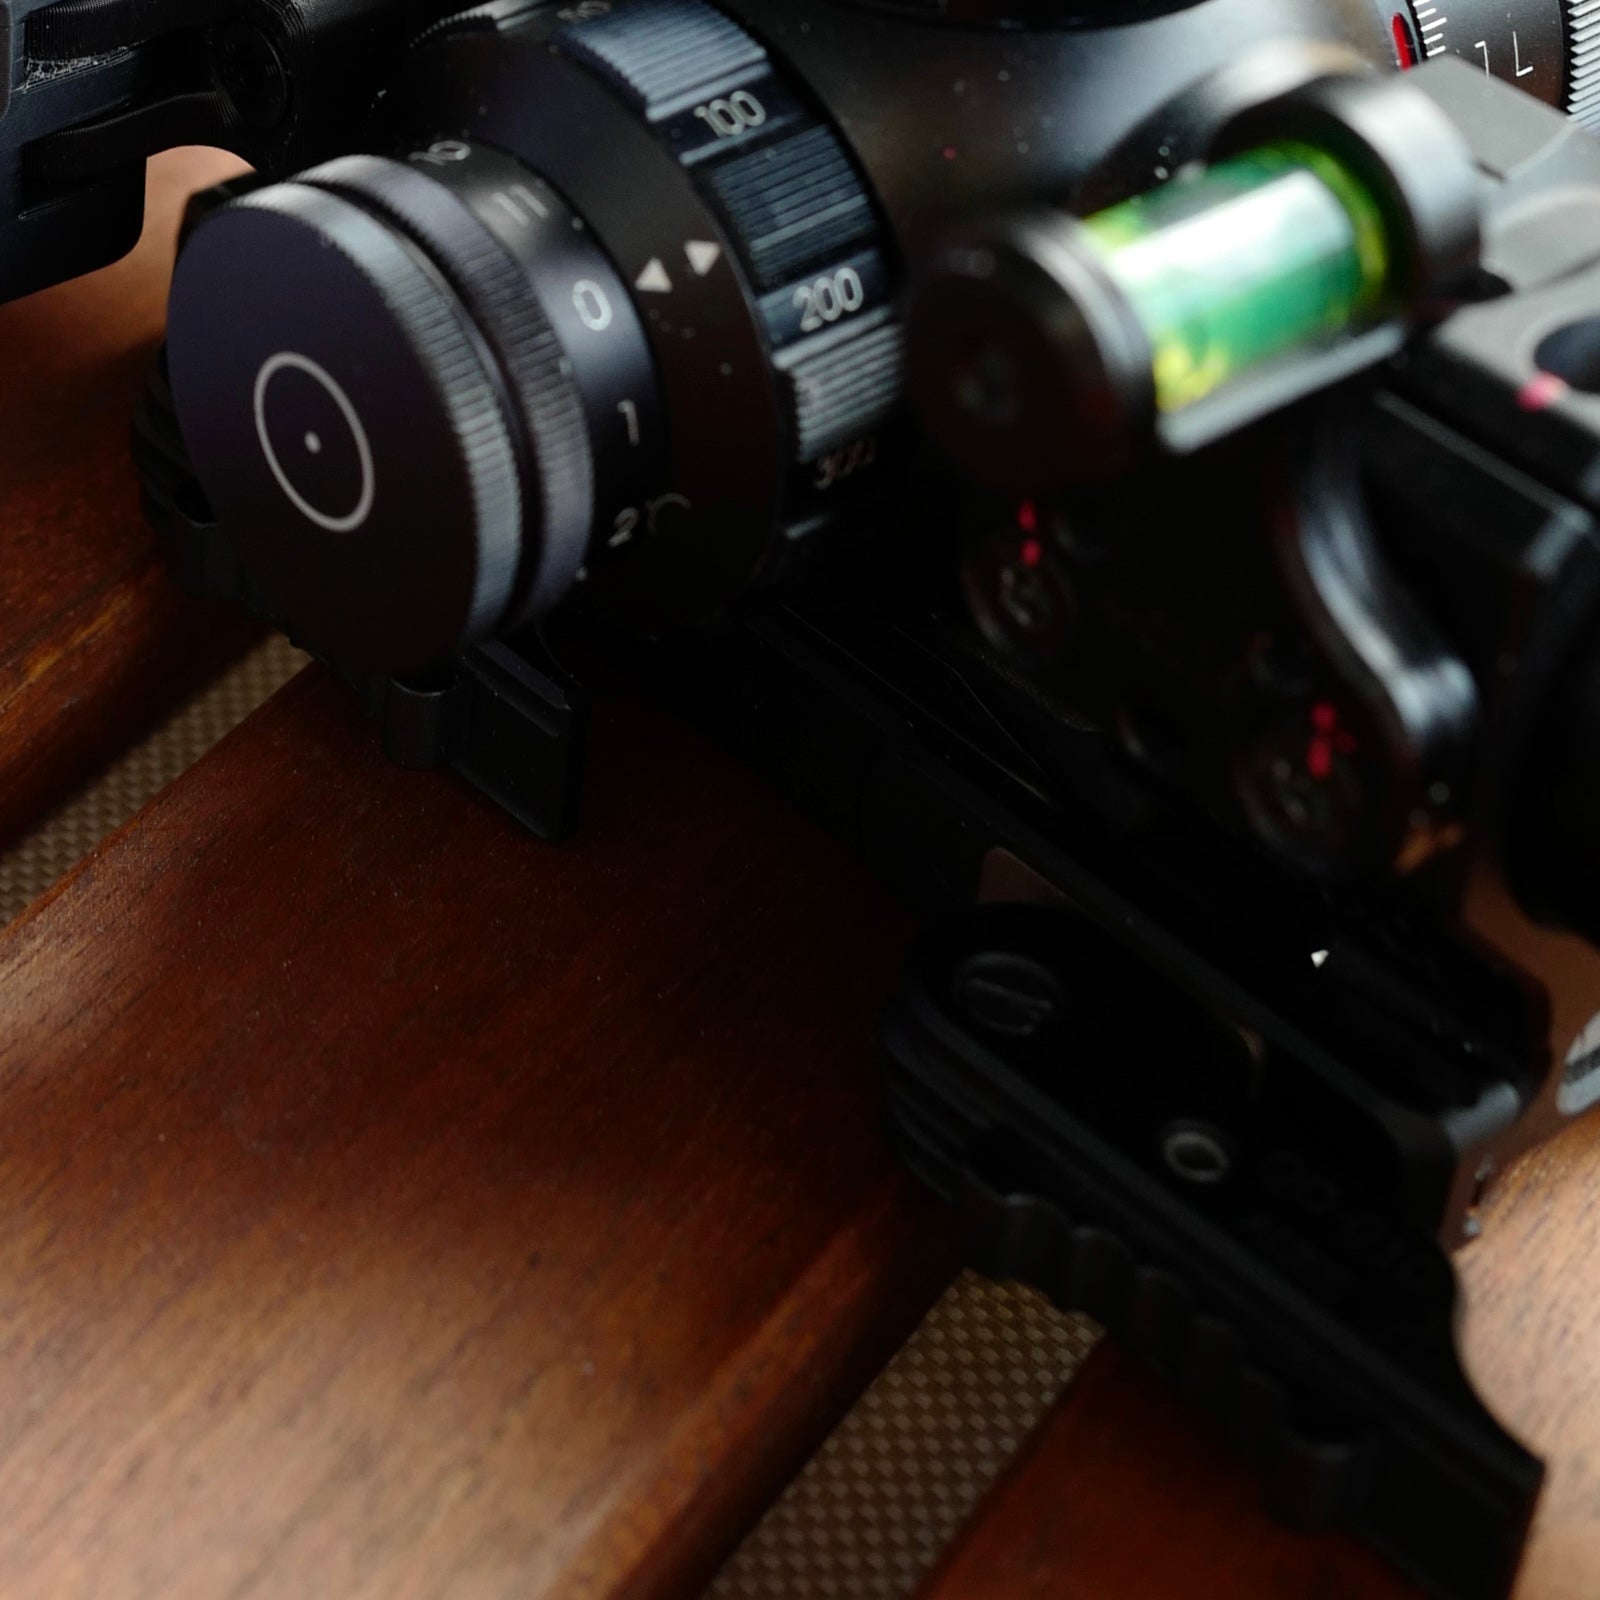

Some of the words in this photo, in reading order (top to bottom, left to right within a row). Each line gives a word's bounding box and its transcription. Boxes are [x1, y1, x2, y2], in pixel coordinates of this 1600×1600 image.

[693, 90, 767, 137] 100
[572, 279, 612, 331] 0
[793, 267, 864, 332] 200
[616, 400, 639, 446] 1
